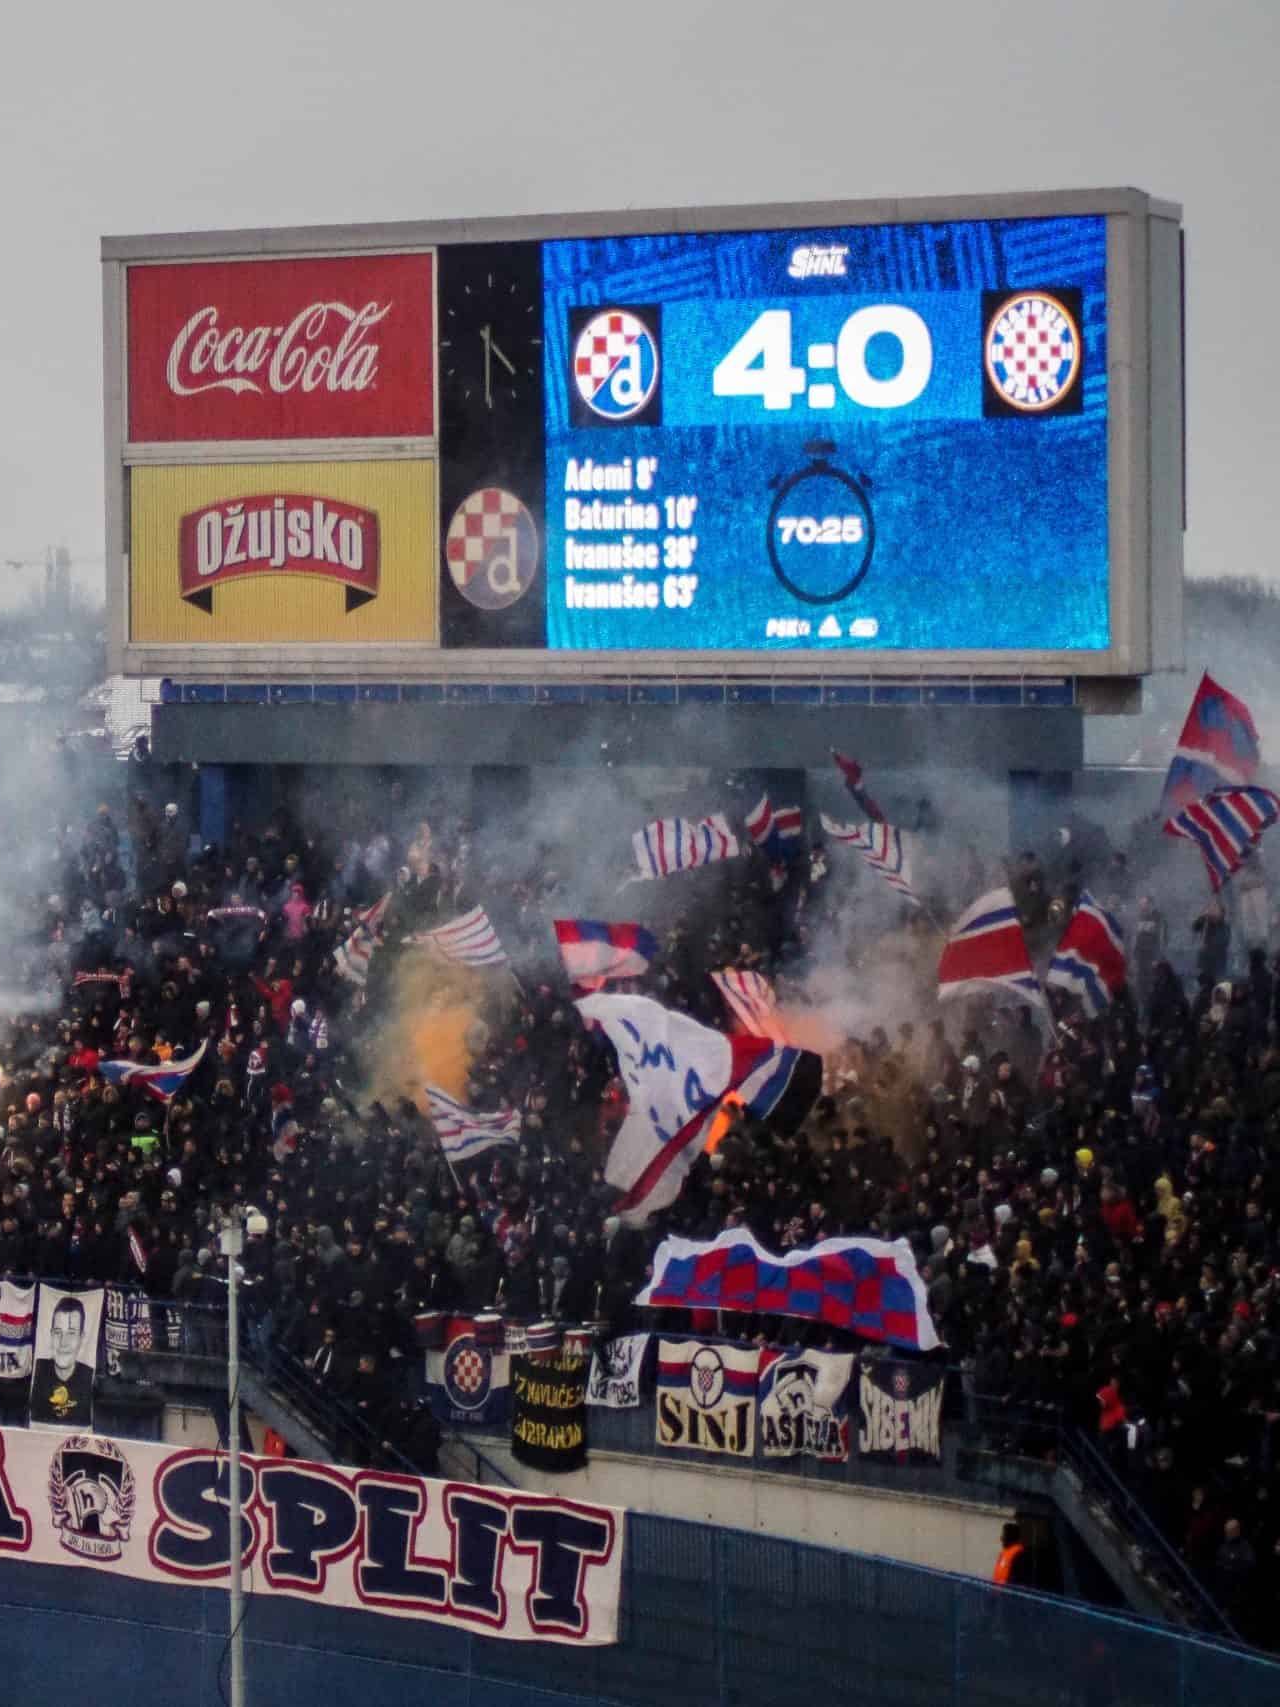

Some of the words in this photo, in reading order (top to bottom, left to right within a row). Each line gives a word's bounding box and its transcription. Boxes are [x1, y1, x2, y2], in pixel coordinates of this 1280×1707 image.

[166, 300, 392, 396] Coca-Cola
[713, 304, 933, 410] 4:0
[564, 458, 632, 491] Ademi
[564, 496, 659, 530] Baturina
[197, 498, 364, 576] Ožujsko
[659, 1392, 751, 1451] SINJ
[148, 1447, 616, 1640] SPLIT
